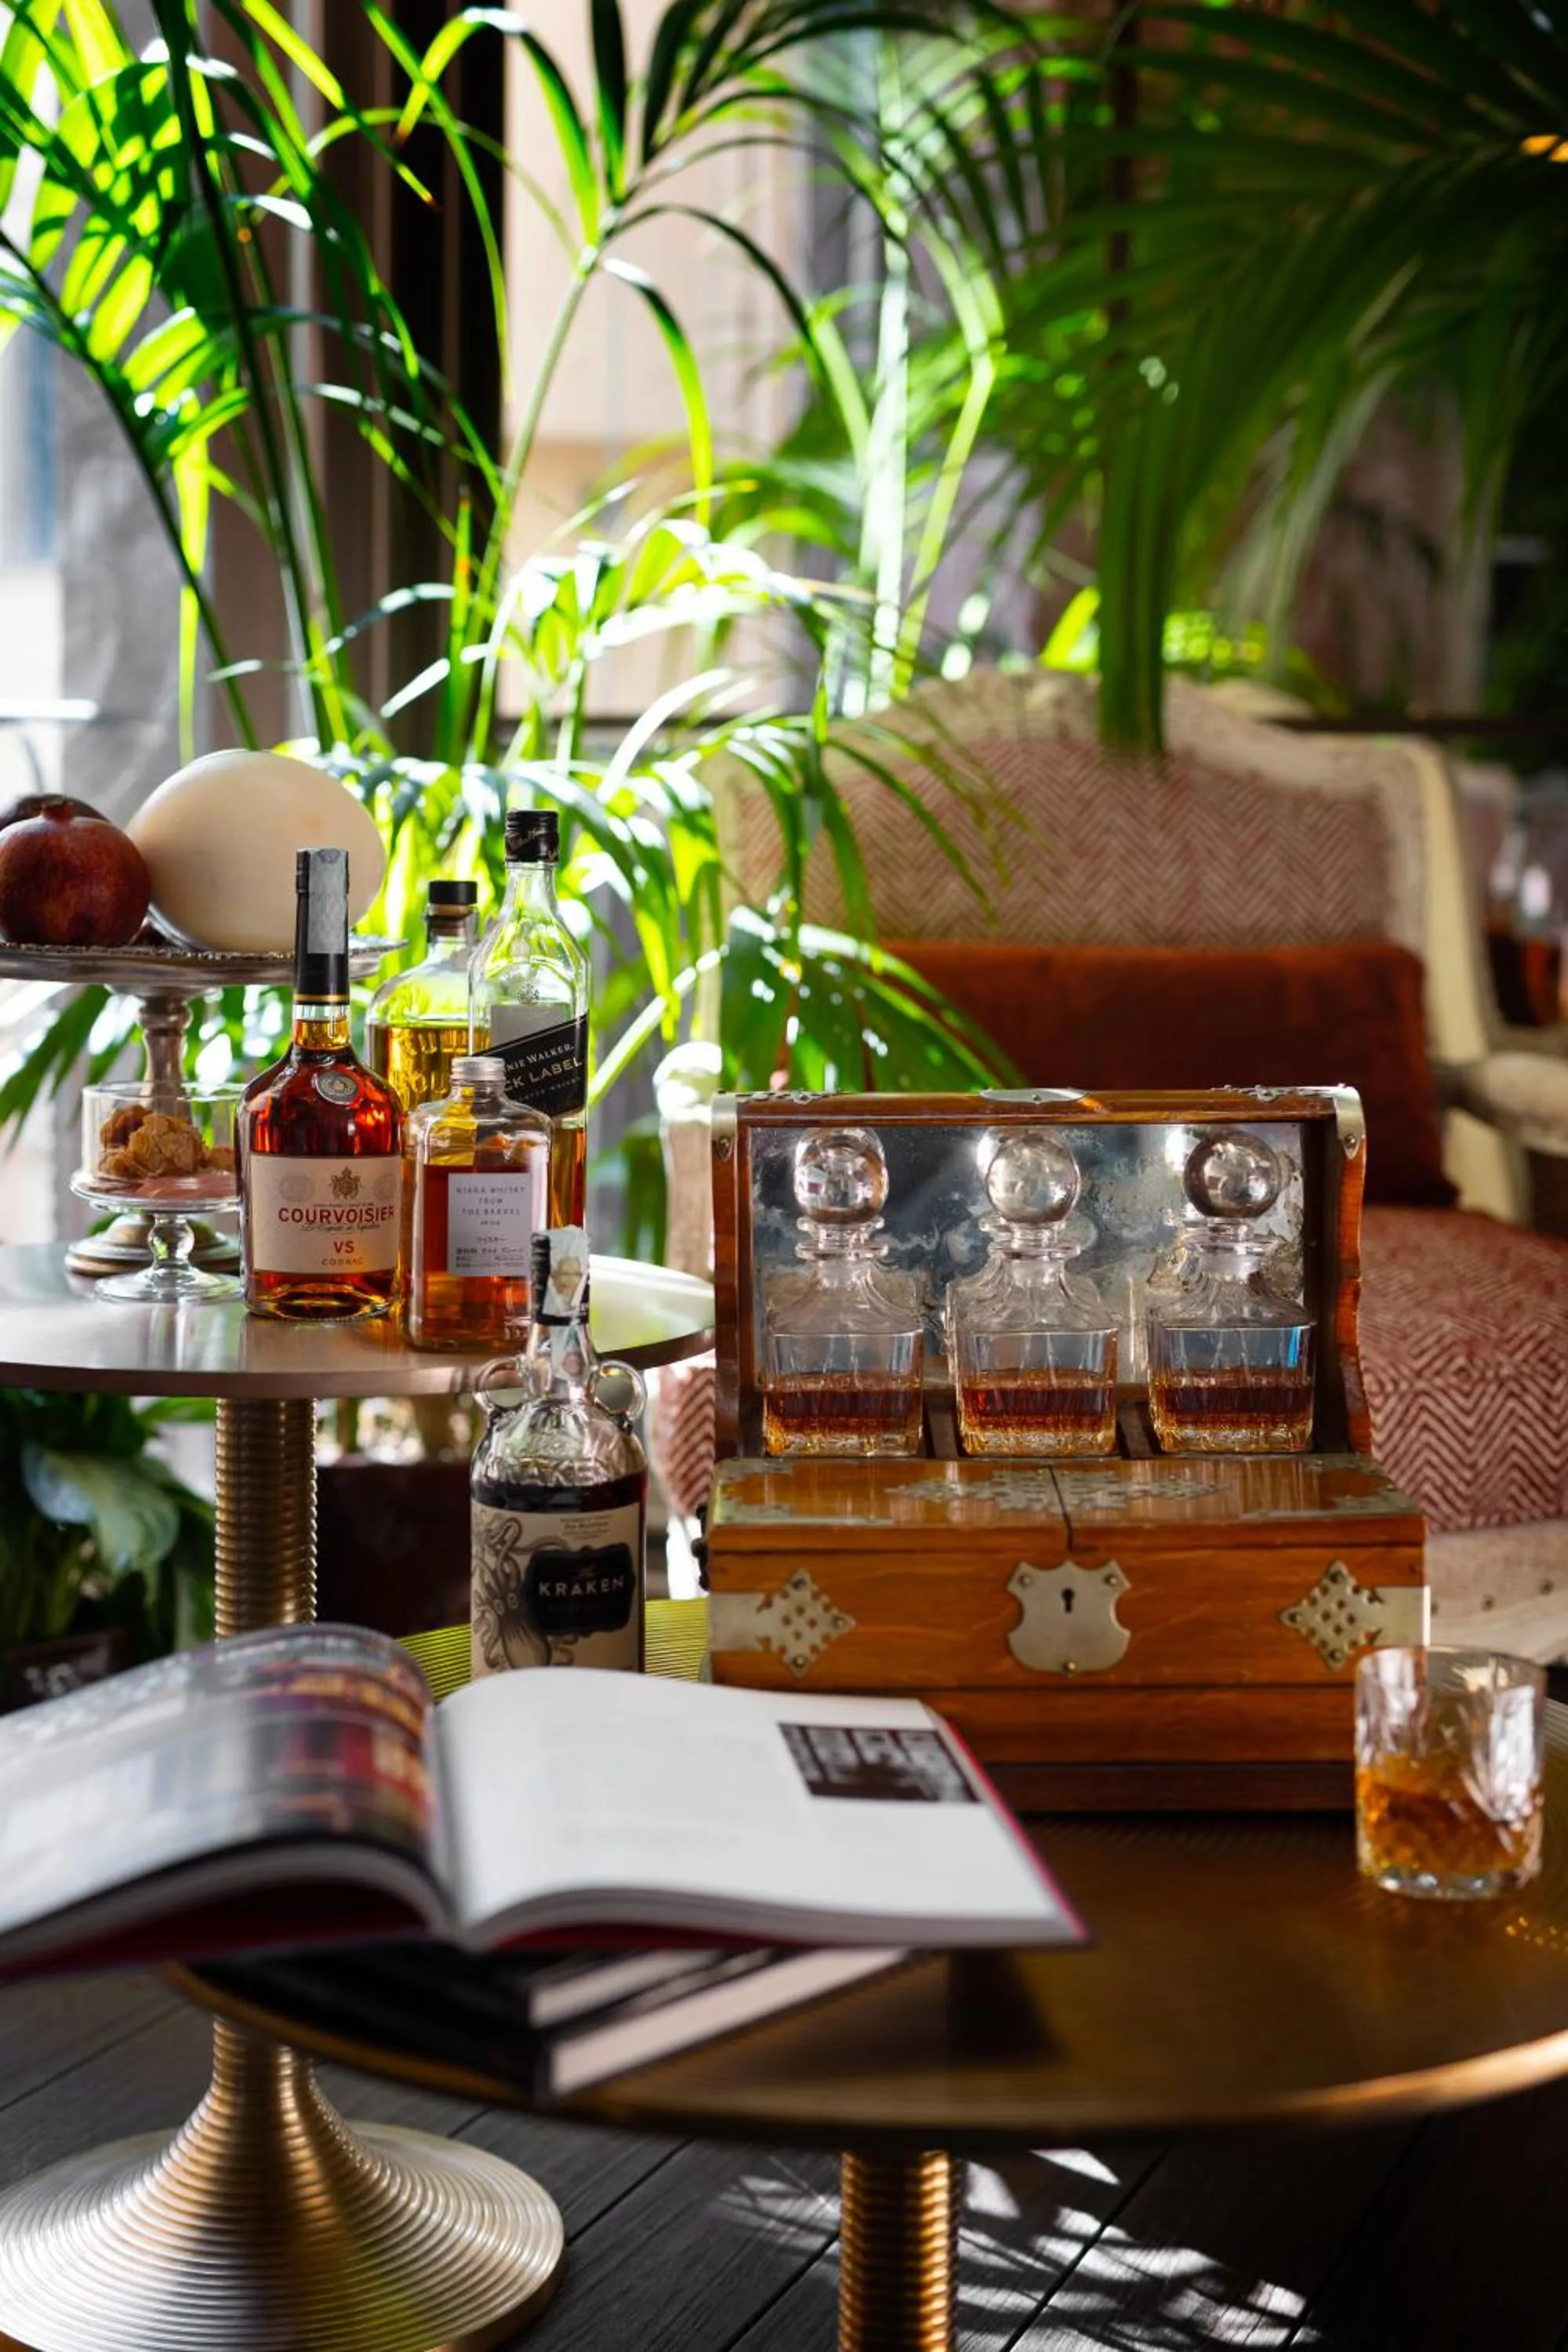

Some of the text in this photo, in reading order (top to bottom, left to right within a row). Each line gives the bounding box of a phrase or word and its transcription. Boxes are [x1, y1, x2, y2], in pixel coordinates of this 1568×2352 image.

[528, 1057, 583, 1083] LABEL
[278, 1206, 394, 1224] COURVOISIER
[333, 1240, 355, 1254] VS
[321, 1257, 363, 1266] COGNAC
[539, 1575, 625, 1597] KRAKEN
